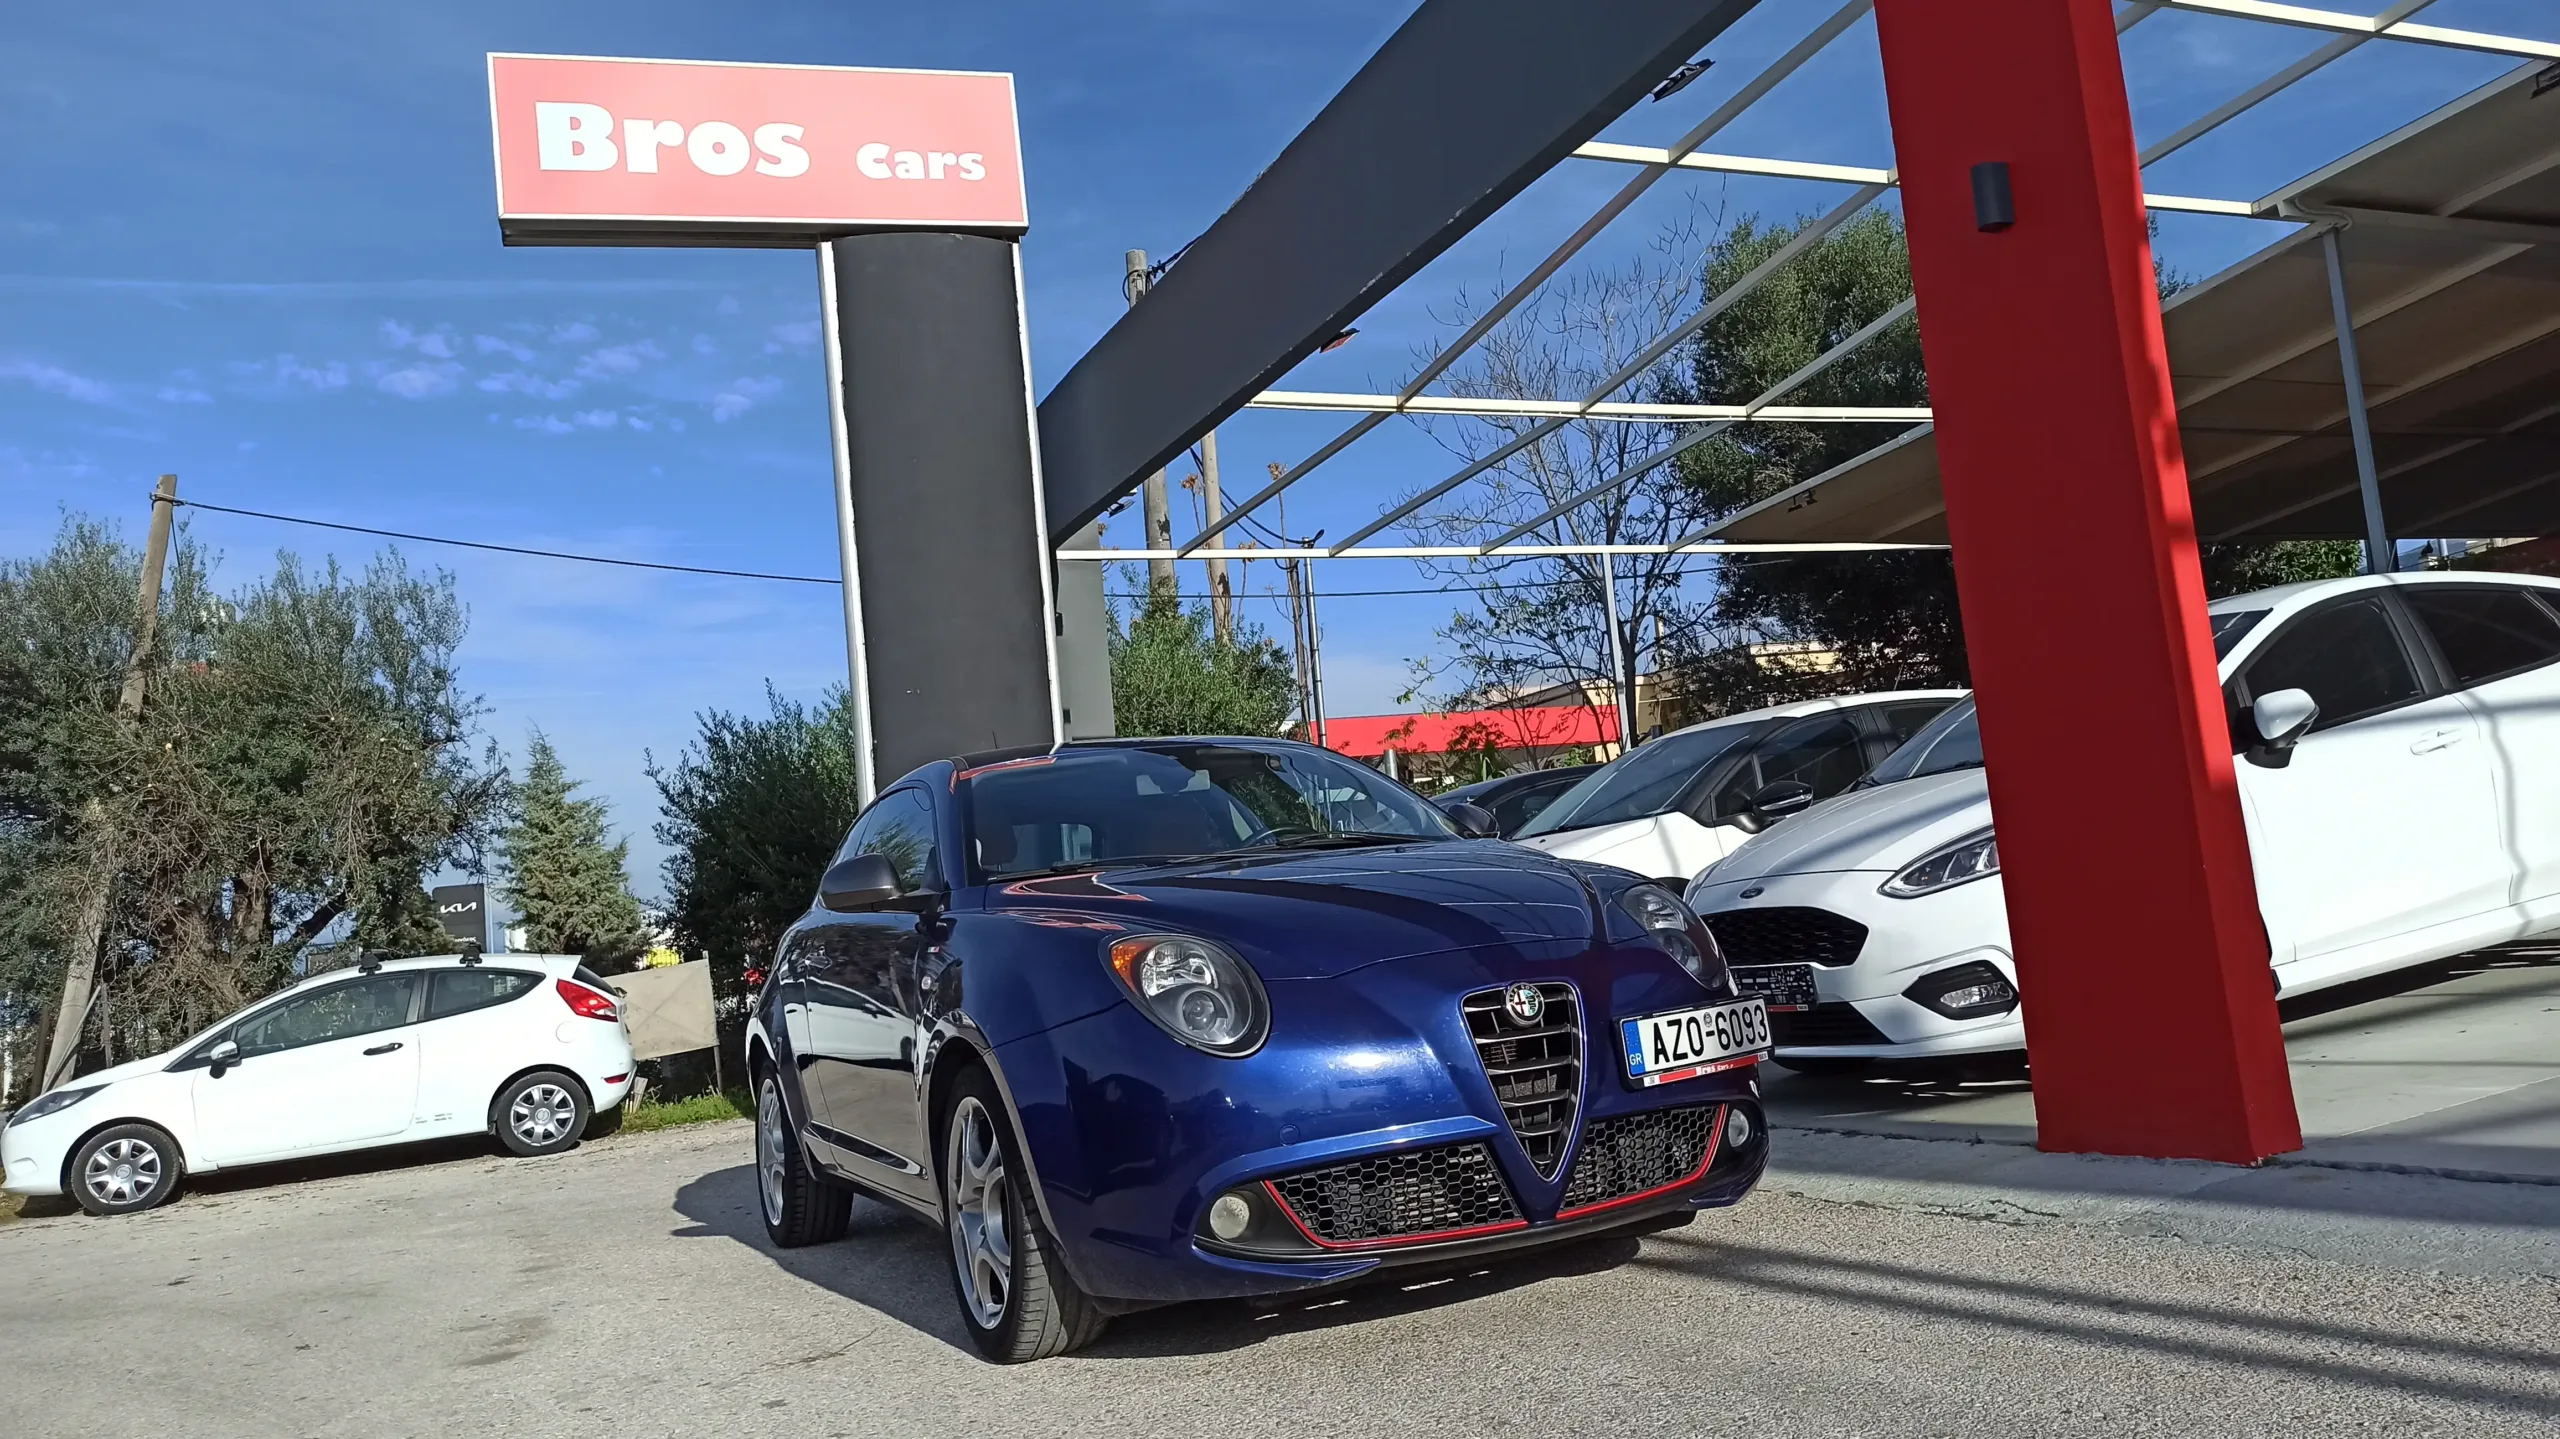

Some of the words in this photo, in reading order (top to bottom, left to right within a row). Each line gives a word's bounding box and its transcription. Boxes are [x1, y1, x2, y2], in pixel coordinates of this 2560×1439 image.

[535, 101, 810, 178] Bros
[856, 142, 986, 181] Cars
[1629, 1053, 1643, 1066] GR
